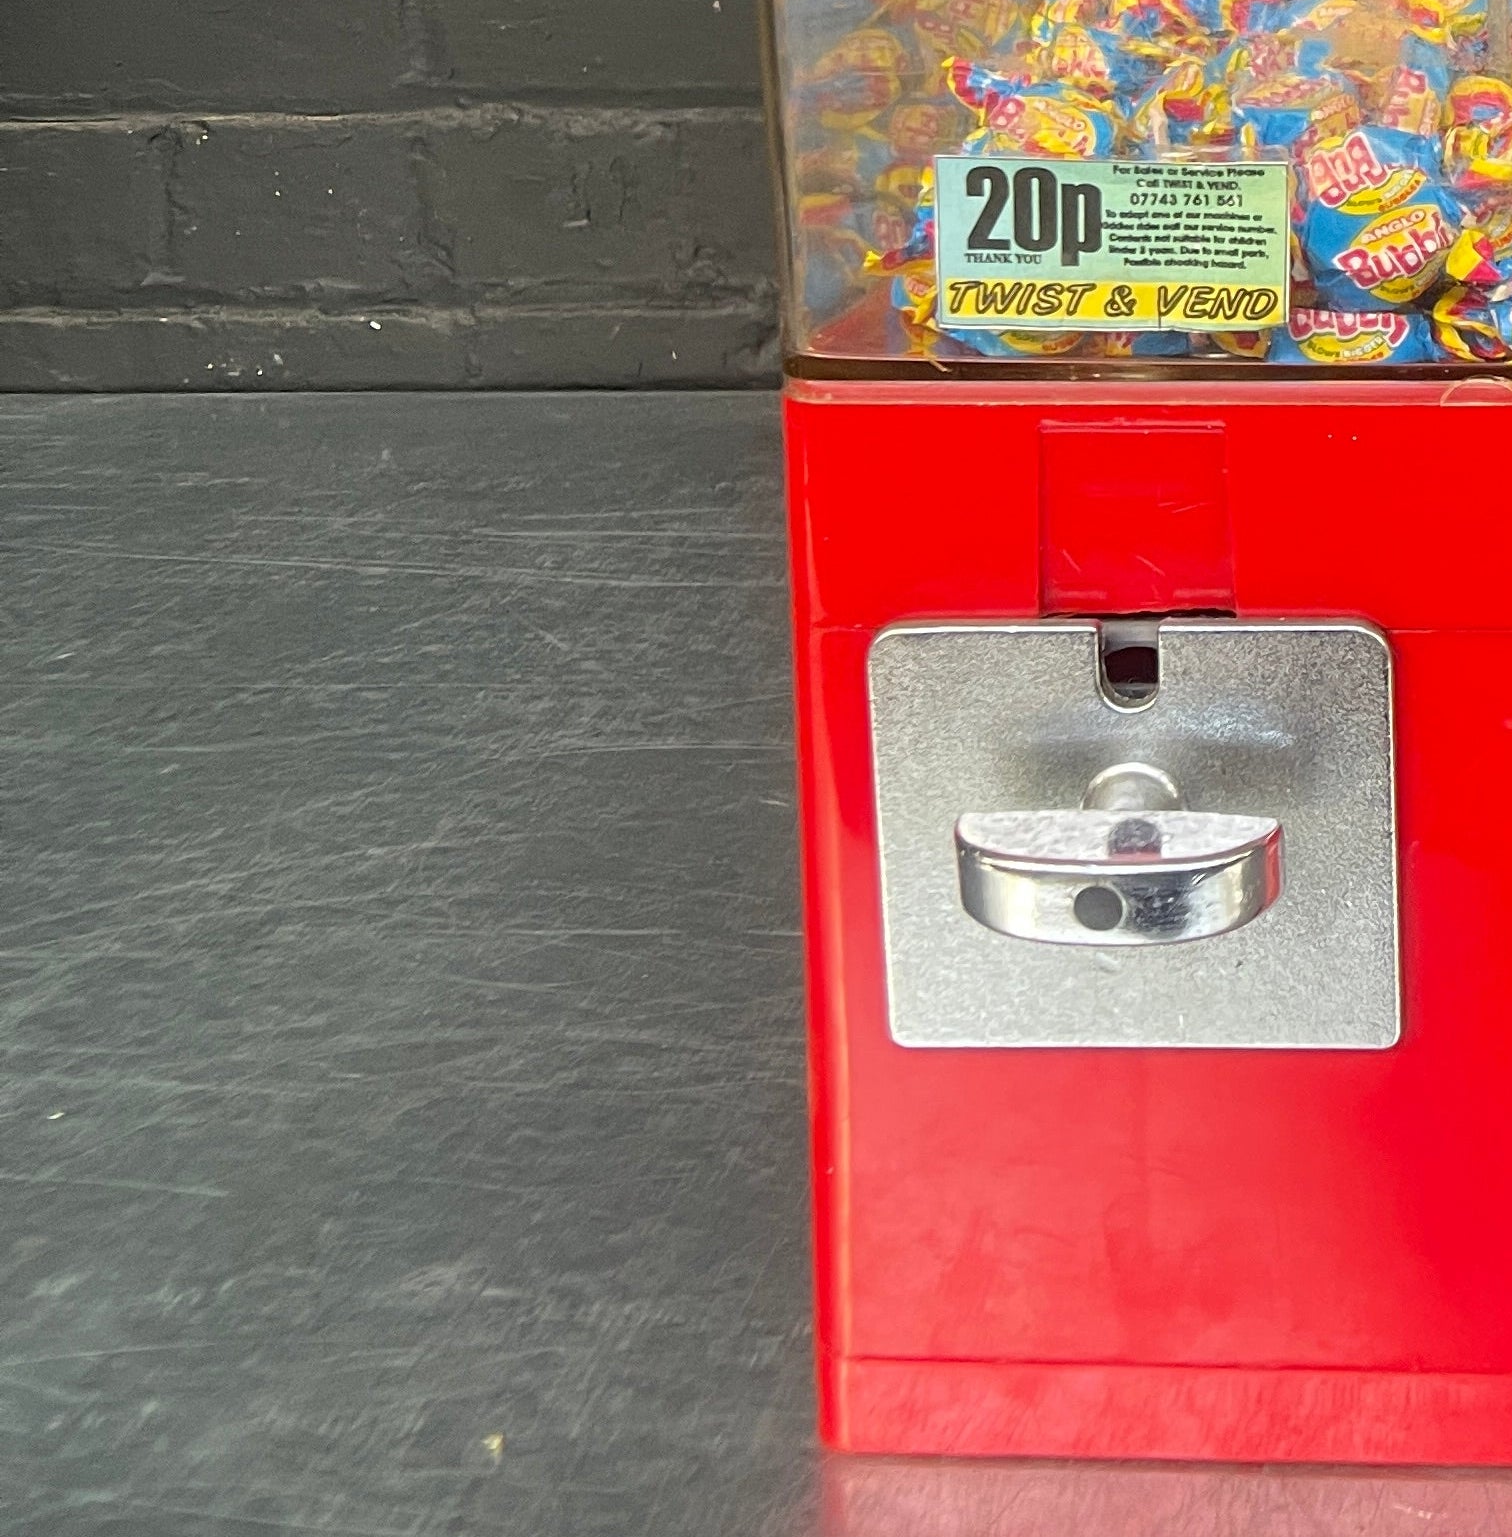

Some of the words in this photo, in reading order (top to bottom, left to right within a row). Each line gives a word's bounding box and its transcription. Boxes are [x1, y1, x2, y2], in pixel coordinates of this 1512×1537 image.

[1113, 165, 1131, 175] For
[1134, 165, 1164, 175] Sales
[1181, 167, 1224, 178] Service
[1227, 168, 1265, 177] Please
[1136, 178, 1160, 188] Call
[1163, 179, 1193, 189] TWIST
[1129, 192, 1178, 206] 07743
[1183, 193, 1210, 206] 761
[1216, 194, 1243, 207] 561
[966, 166, 1103, 266] 20p
[1360, 208, 1427, 245] ANGLO
[965, 253, 1012, 264] THANK
[1014, 253, 1043, 264] YOU
[949, 281, 1098, 315] TWIST
[1103, 285, 1137, 316] &
[1157, 285, 1279, 321] VEND
